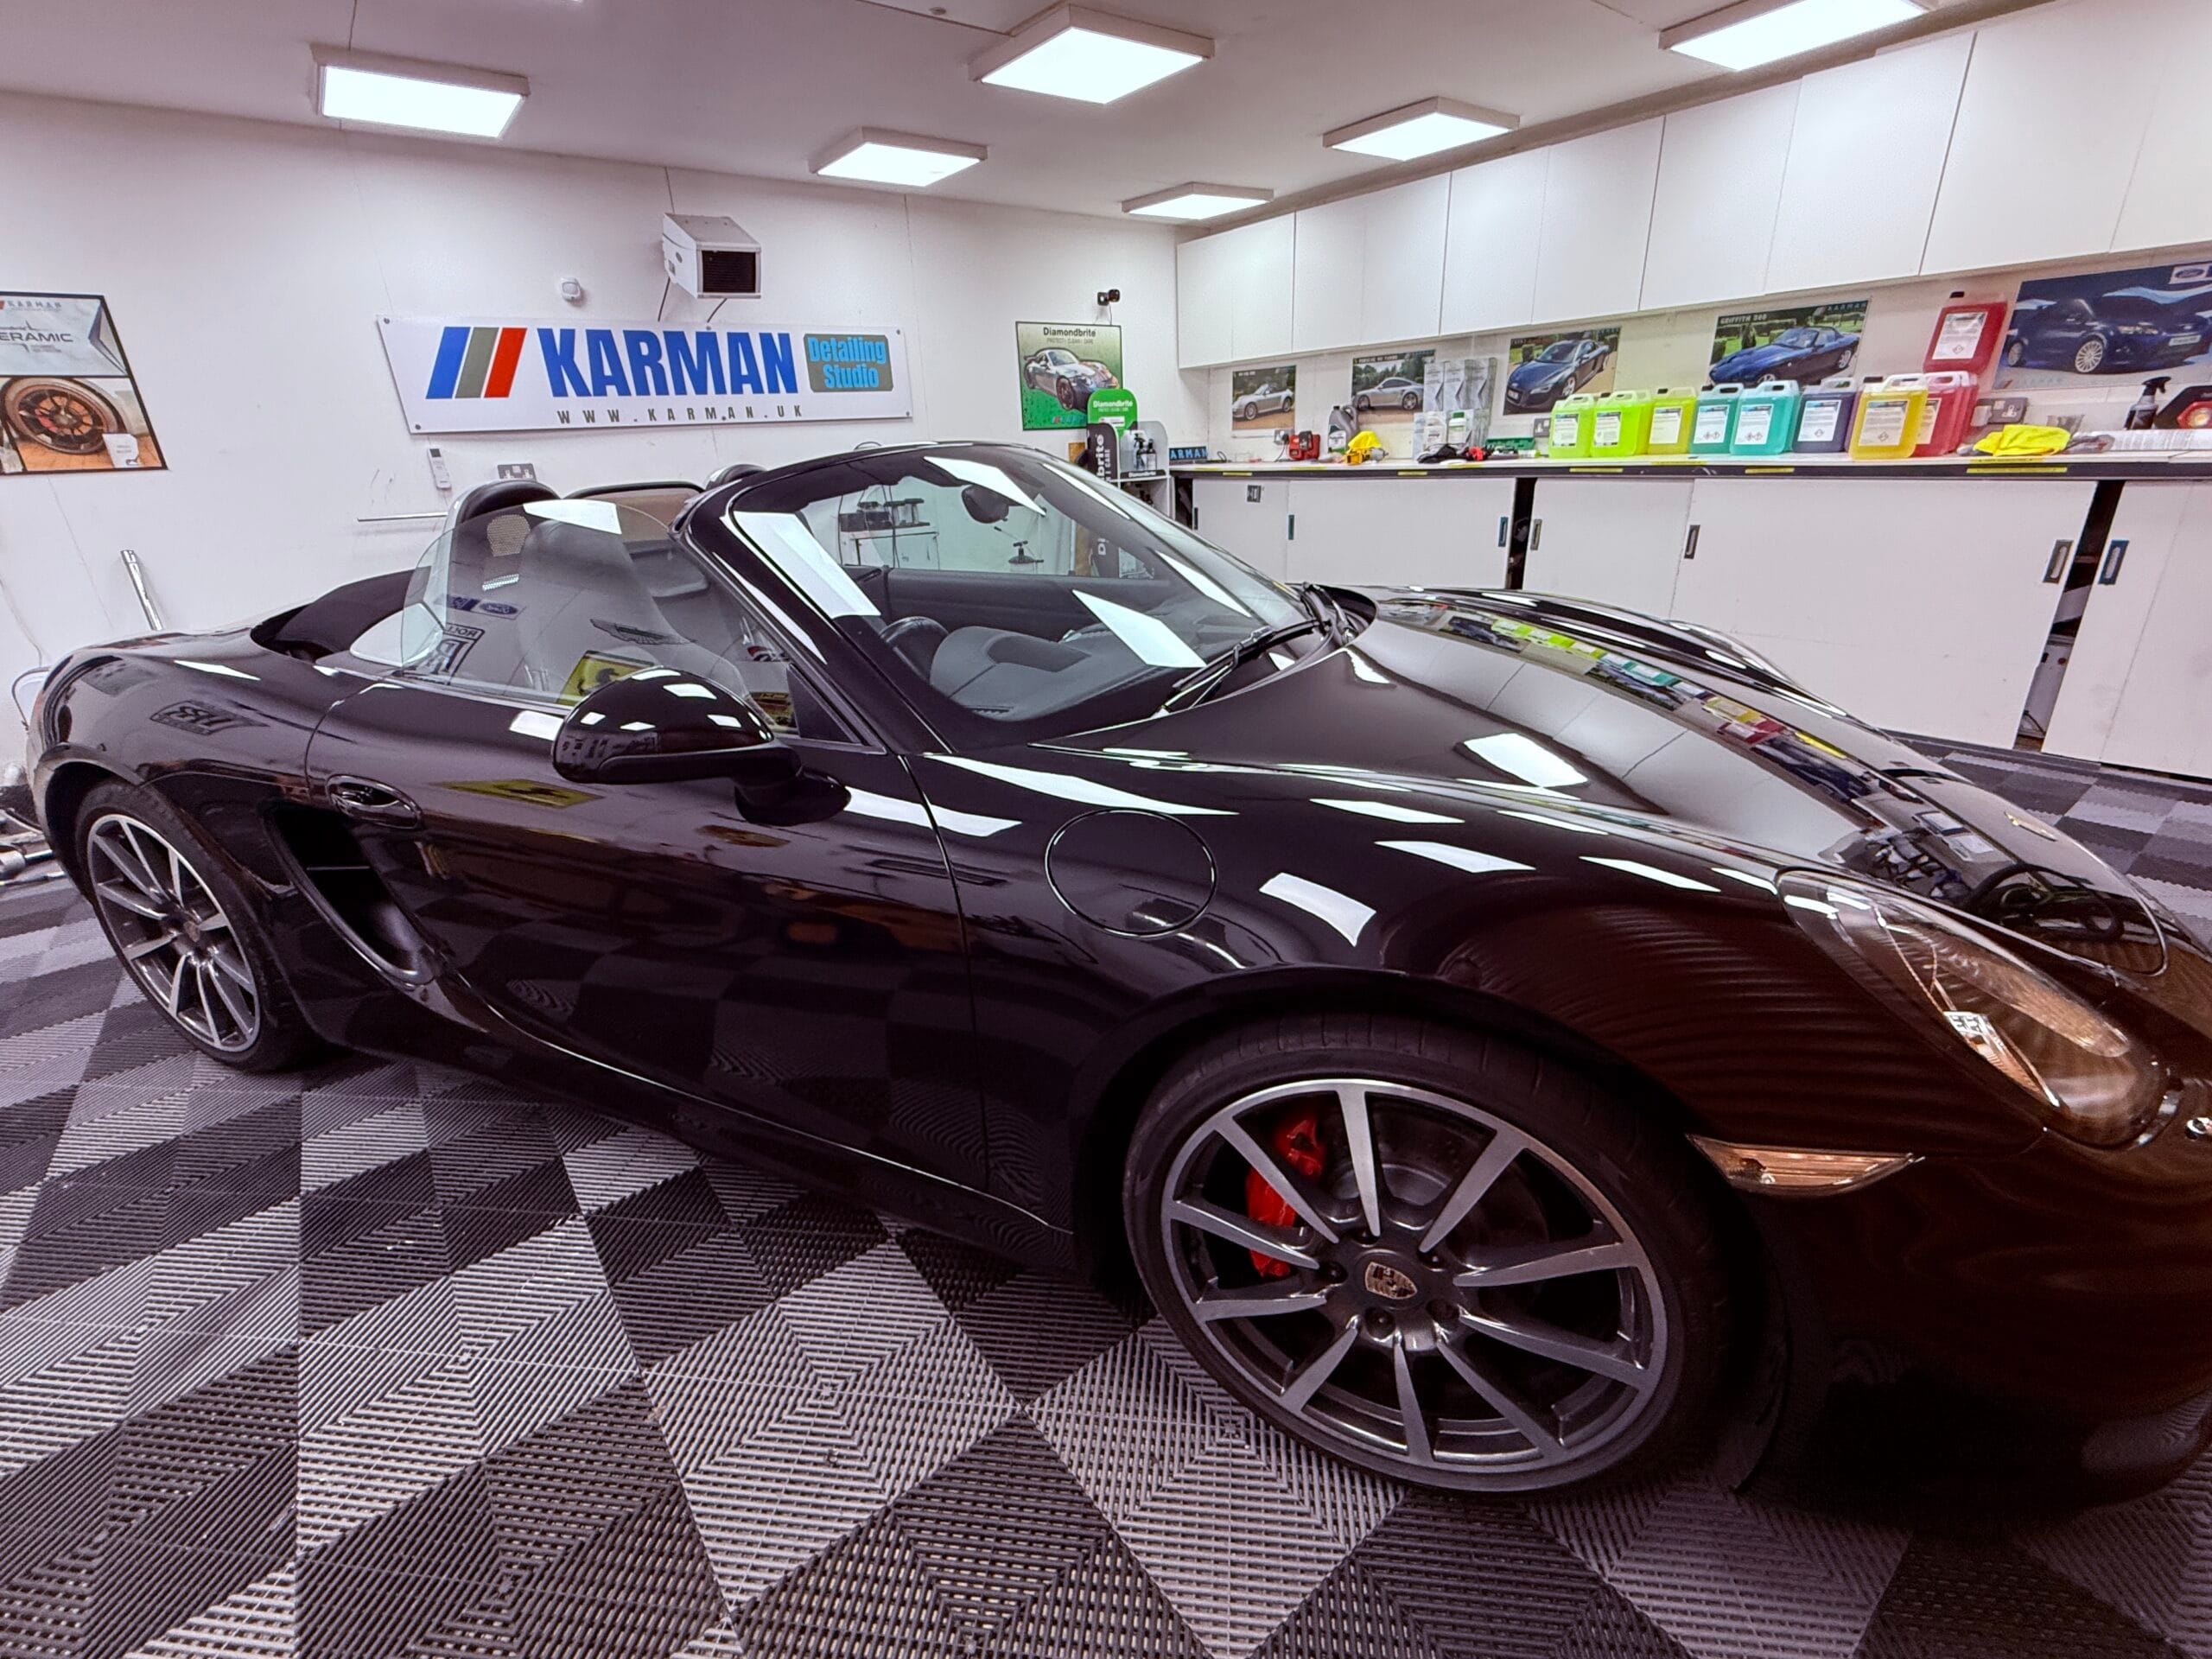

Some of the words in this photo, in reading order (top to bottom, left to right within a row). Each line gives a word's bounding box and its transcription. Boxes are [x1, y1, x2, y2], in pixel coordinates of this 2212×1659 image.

[1043, 327, 1096, 338] Diamondbrite
[537, 328, 798, 397] KARMAN
[808, 336, 887, 364] Detailing
[823, 364, 879, 388] Studio
